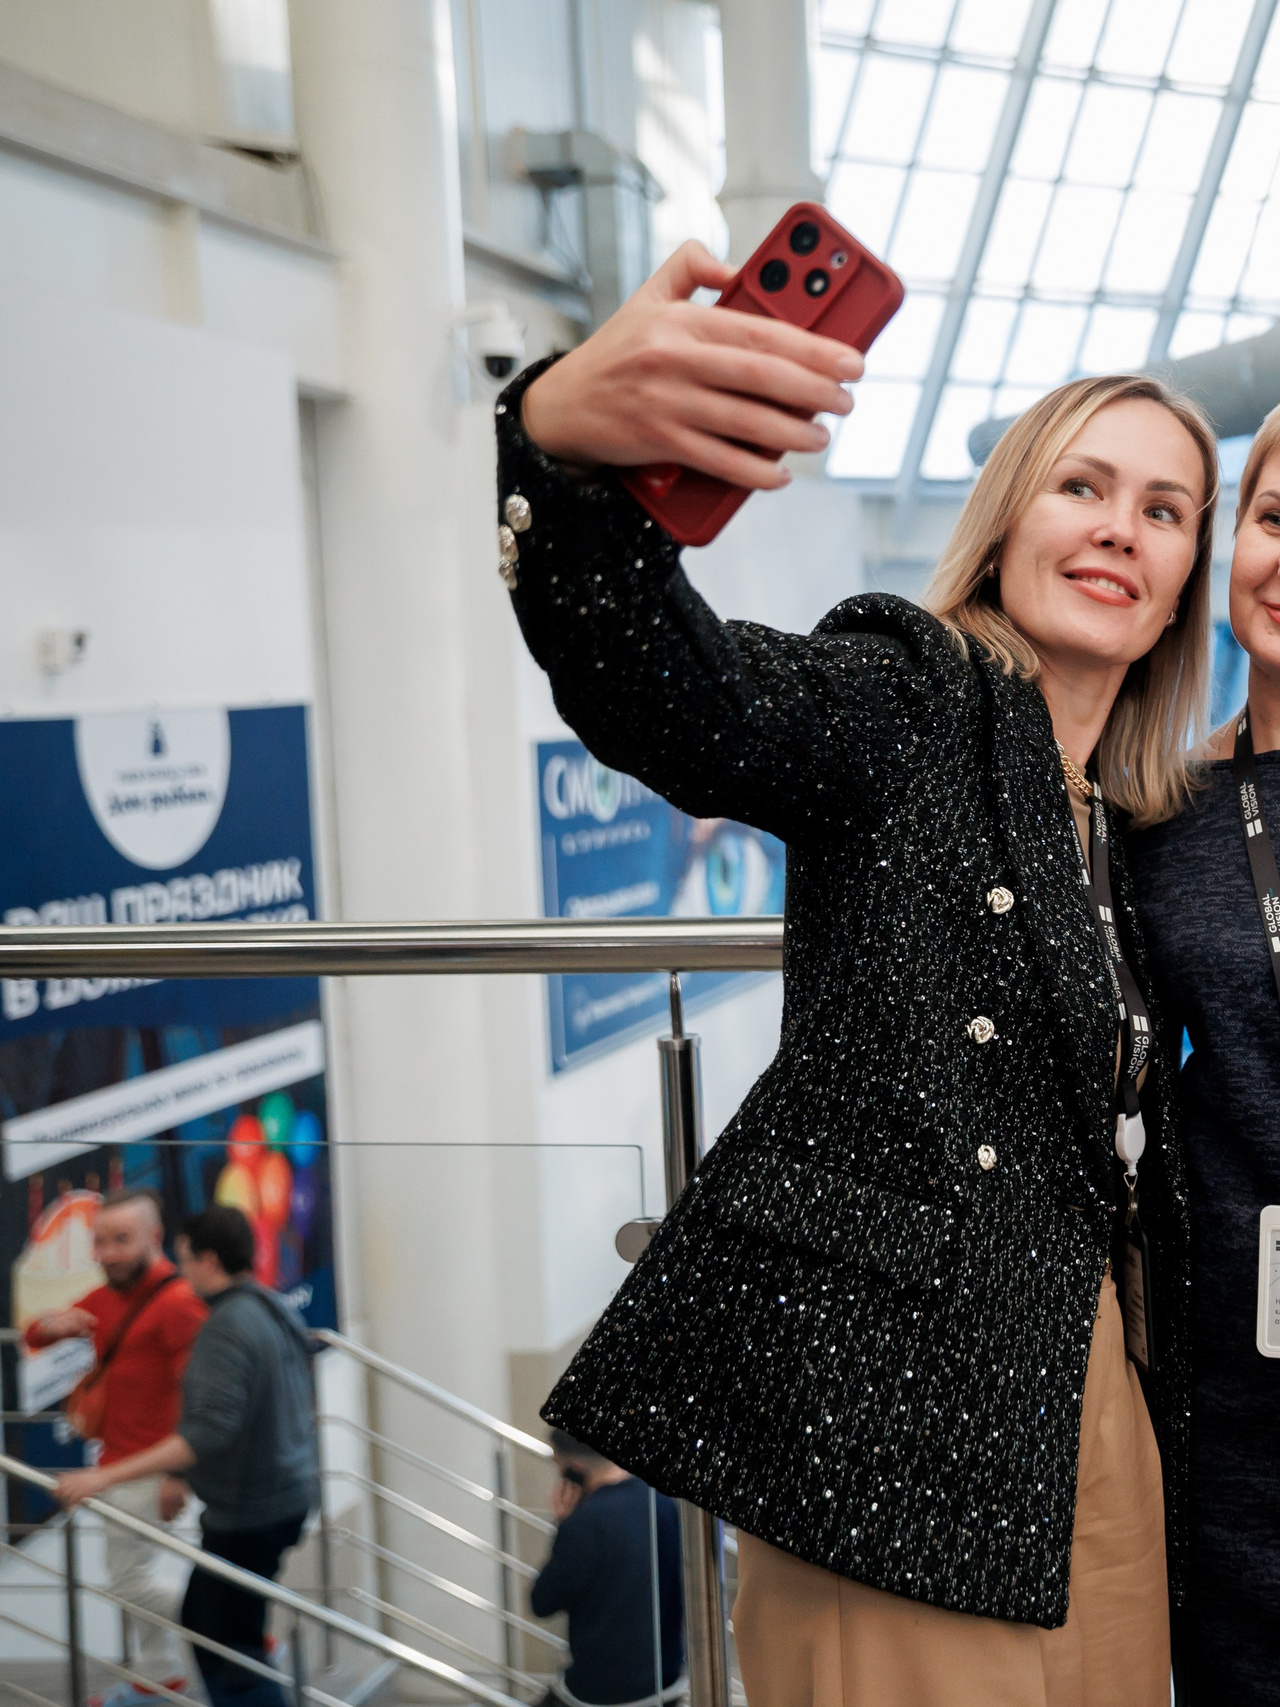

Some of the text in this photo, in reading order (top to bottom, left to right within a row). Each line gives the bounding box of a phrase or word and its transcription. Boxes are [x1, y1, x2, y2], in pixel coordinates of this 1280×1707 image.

[1094, 801, 1102, 837] VISION
[1239, 781, 1252, 820] GLOBAL
[1247, 783, 1260, 817] VISION
[1099, 803, 1107, 844] GLOBAL
[1262, 893, 1278, 933] GLOBAL
[1107, 925, 1124, 963] GLOBAL
[1127, 1035, 1142, 1075] VISION
[1130, 1035, 1150, 1080] GLOBAL
